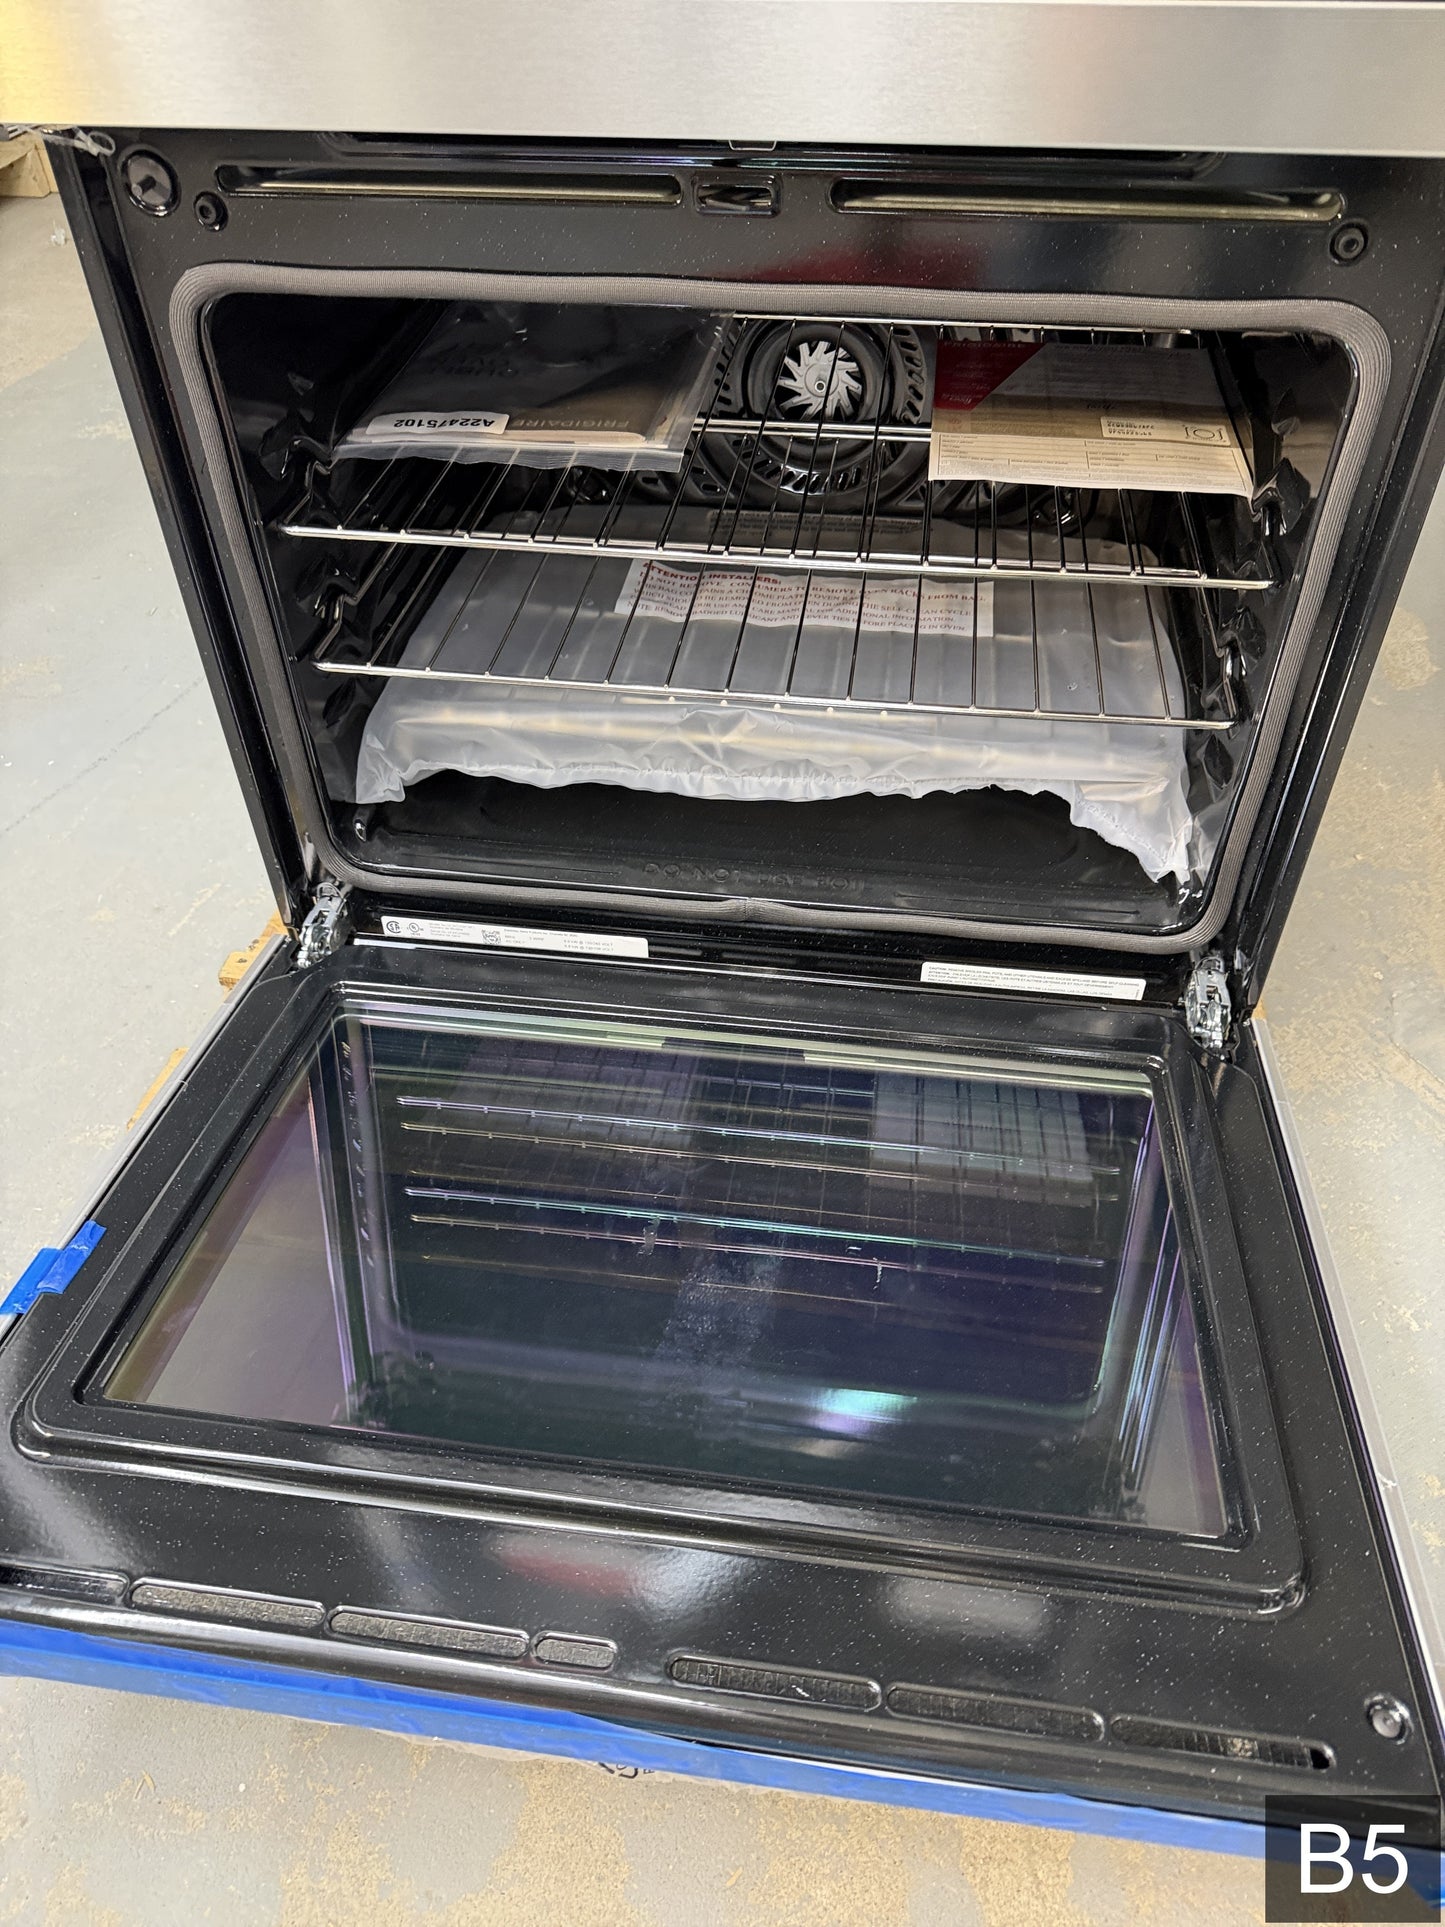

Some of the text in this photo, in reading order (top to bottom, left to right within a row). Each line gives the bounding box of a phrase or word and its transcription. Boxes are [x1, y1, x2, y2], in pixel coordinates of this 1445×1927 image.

[512, 419, 629, 428] FRIGIDAIRE
[643, 562, 706, 581] ATTENTIO
[730, 582, 792, 592] CONUMERS
